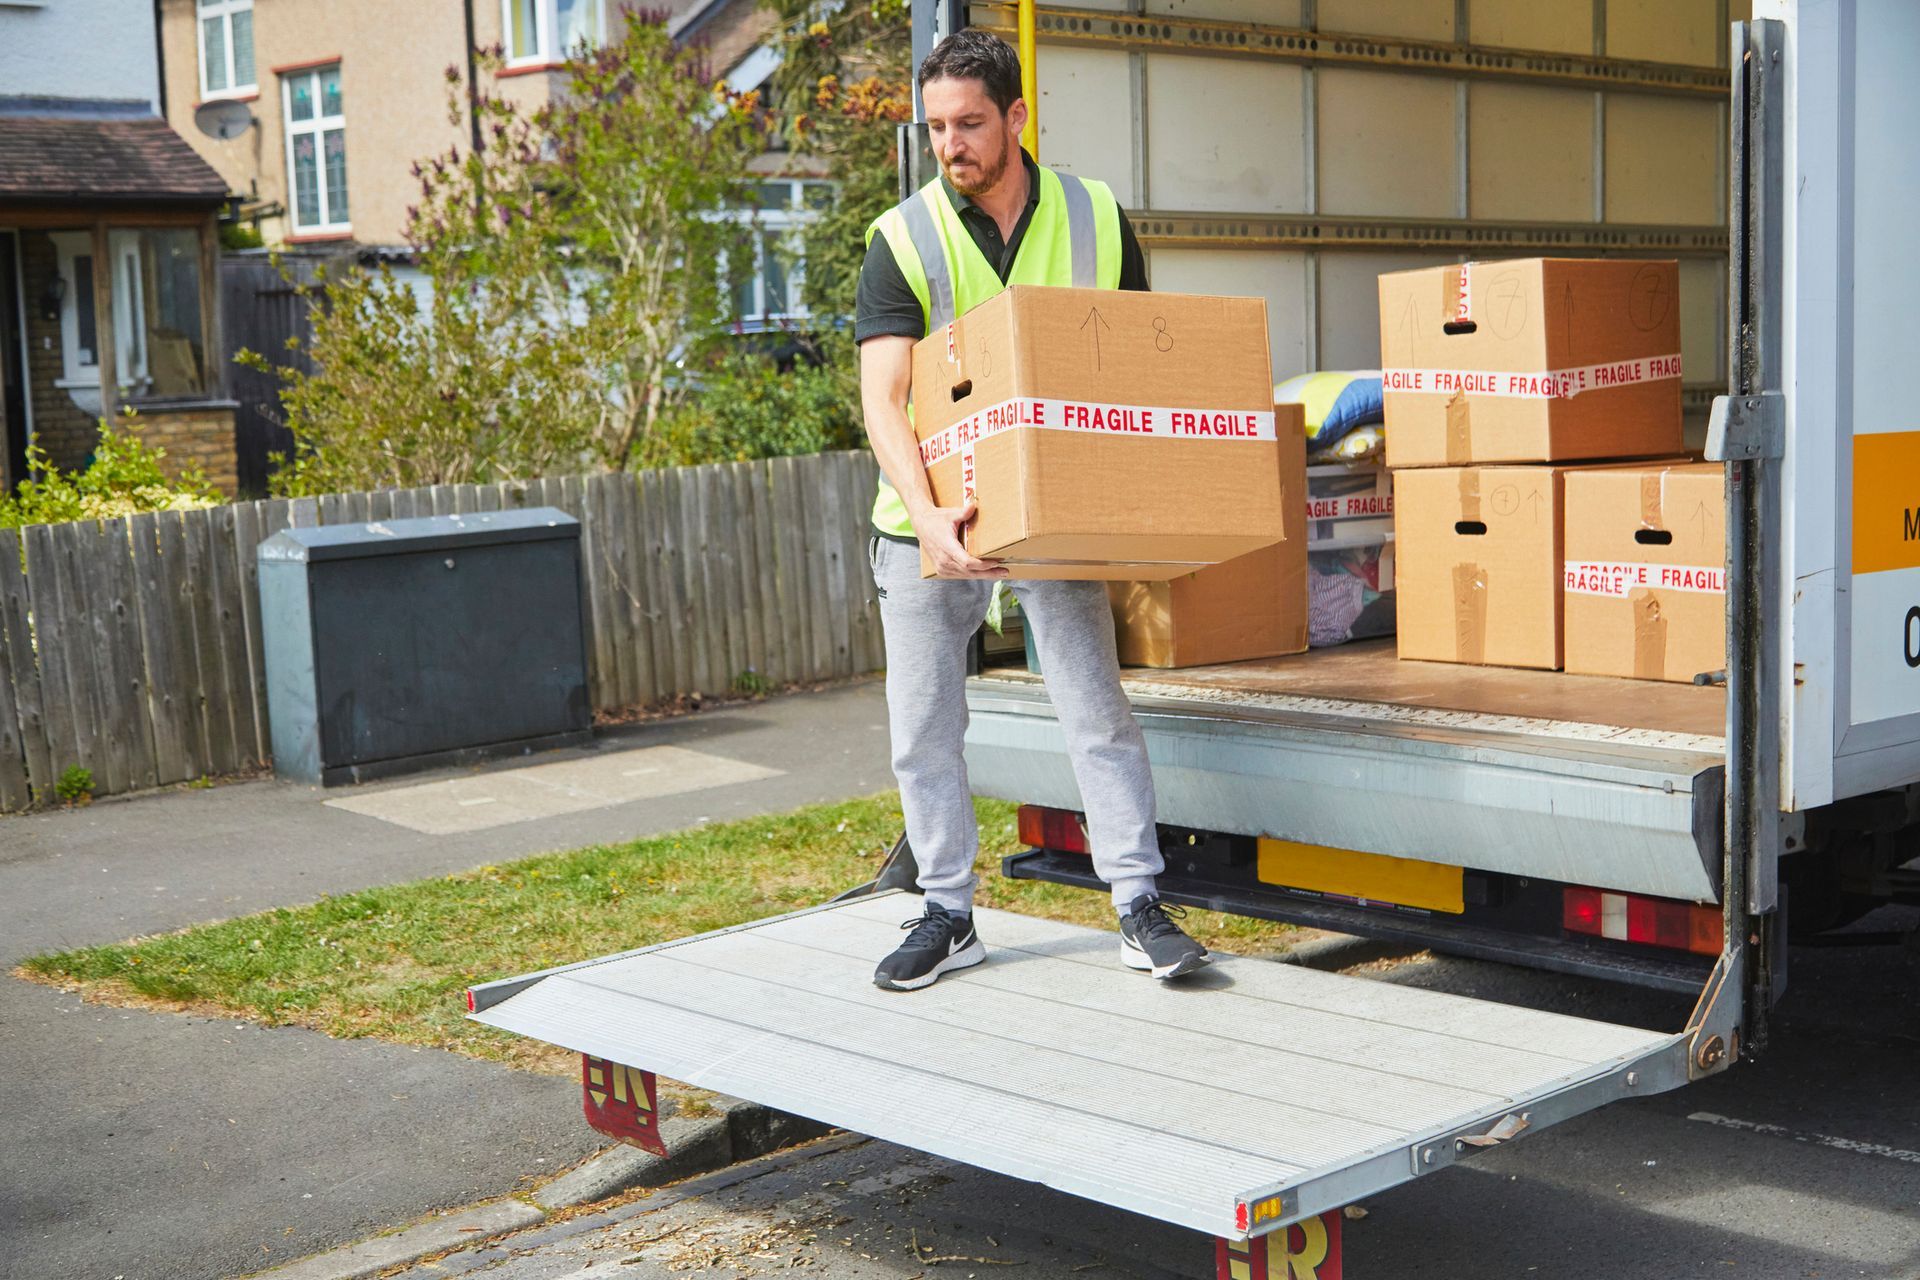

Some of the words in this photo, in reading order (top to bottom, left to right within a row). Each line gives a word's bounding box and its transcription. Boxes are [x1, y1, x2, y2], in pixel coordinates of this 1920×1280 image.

[1152, 316, 1174, 352] 8
[1383, 371, 1423, 390] AGILE
[1435, 373, 1496, 392] FRAGILE
[1509, 376, 1571, 399] FRAGILE
[1594, 362, 1642, 386] FRAGILE
[1650, 356, 1682, 378] FRAGI
[919, 432, 951, 465] AGILE
[987, 402, 1045, 433] FRAGILE
[1064, 405, 1153, 432] FRAGILE
[1171, 412, 1258, 437] FRAGILE
[1346, 496, 1393, 515] FRAGILE
